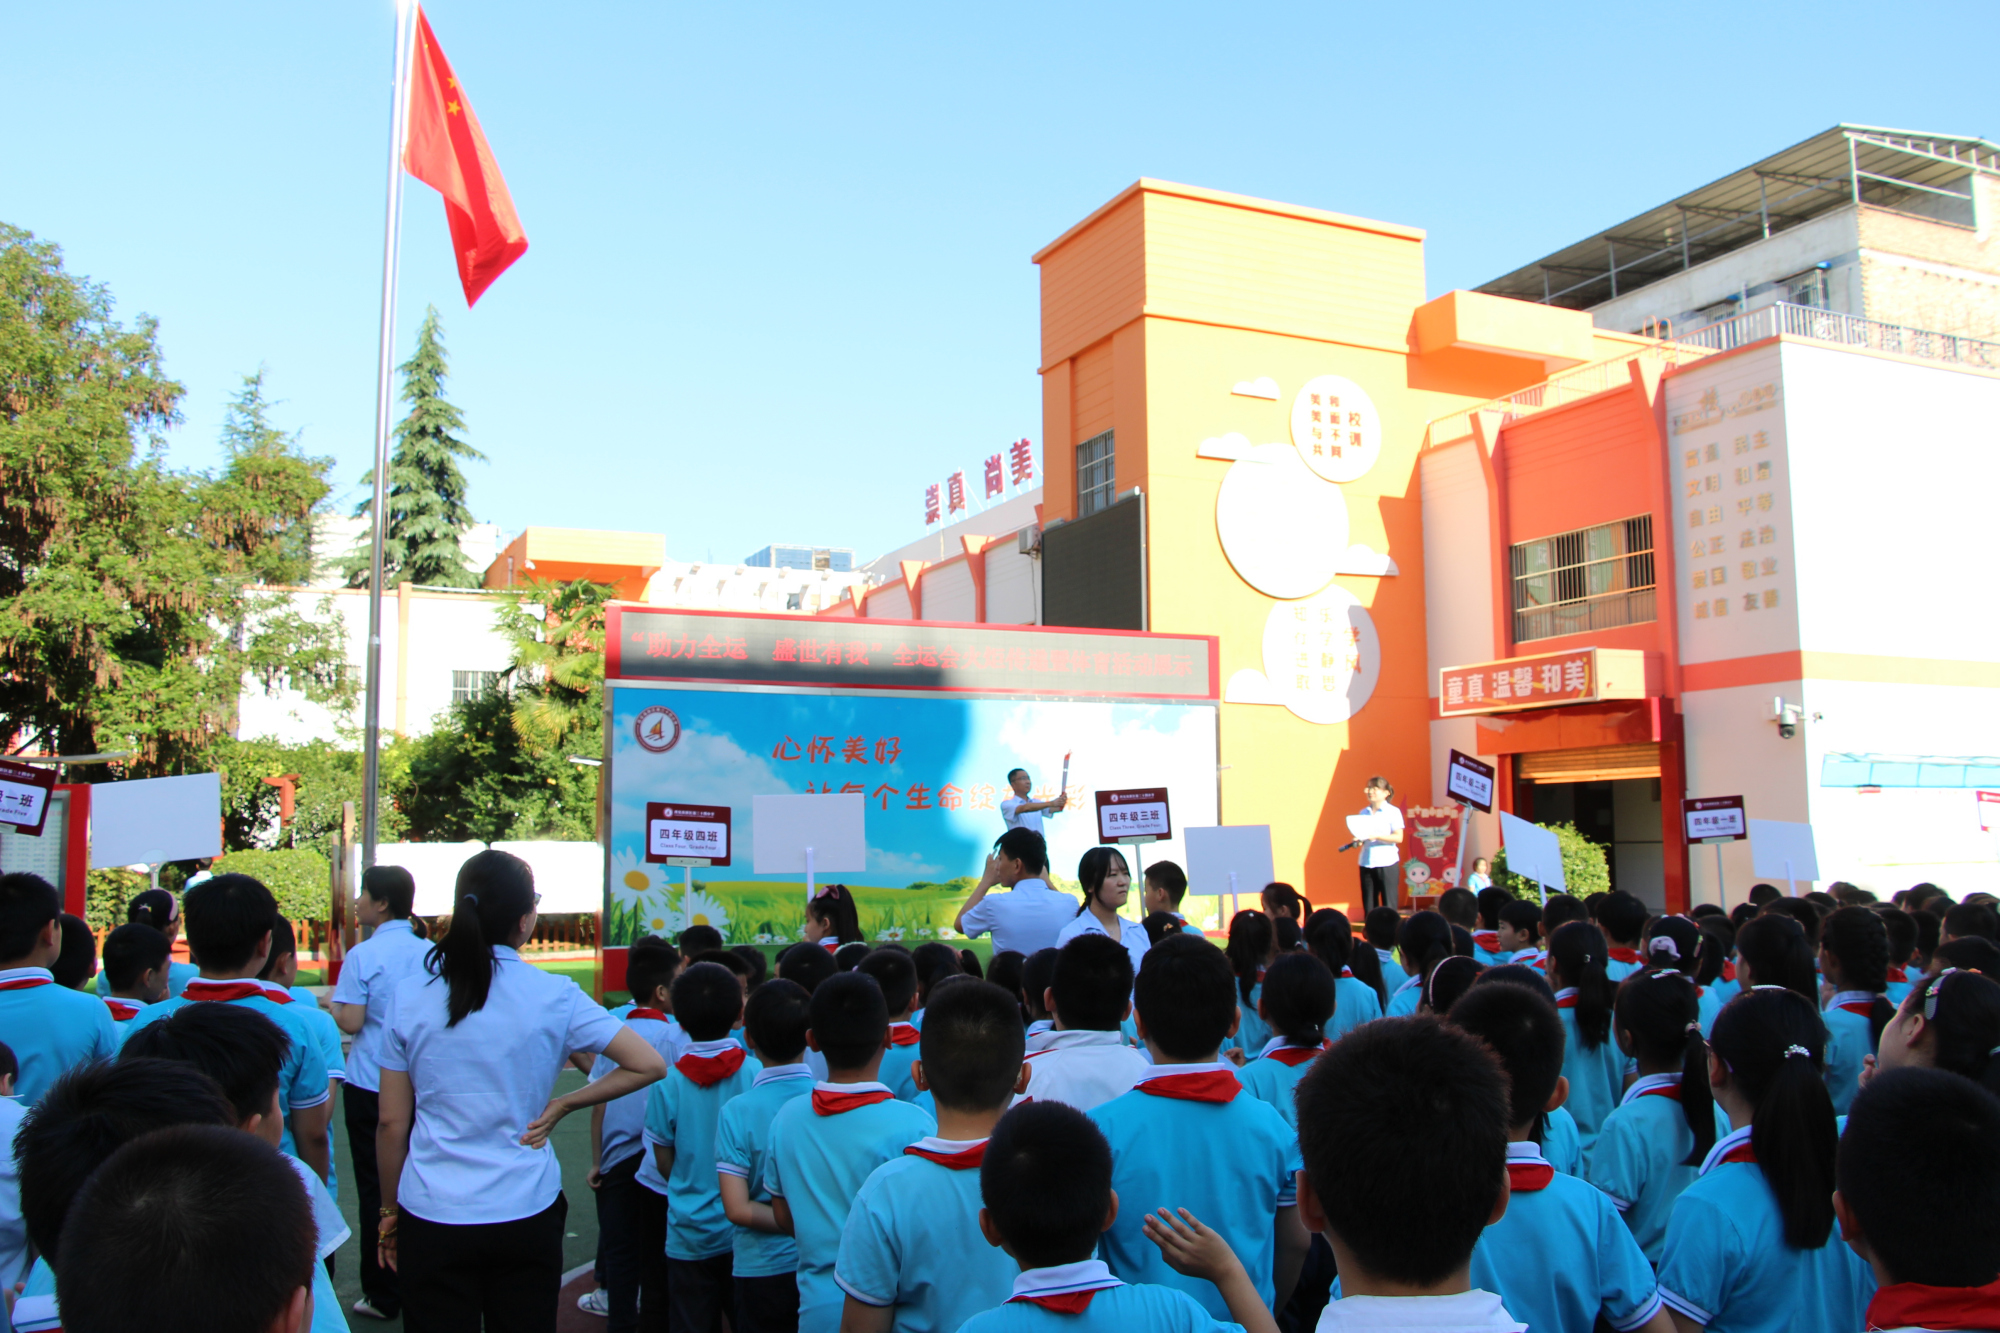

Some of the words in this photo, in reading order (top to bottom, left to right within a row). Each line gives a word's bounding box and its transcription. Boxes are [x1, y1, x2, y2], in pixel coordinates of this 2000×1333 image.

[1349, 411, 1361, 447] 校训
[1734, 430, 1769, 455] 民主
[984, 437, 1032, 500] 尚美
[1686, 474, 1721, 498] 文明
[1735, 461, 1771, 486] 和谐
[1690, 505, 1722, 528] 自由
[1737, 492, 1773, 517] 平等
[1690, 535, 1725, 558] 公正
[1739, 525, 1776, 549] 法治
[1692, 566, 1727, 589] 爱国
[1741, 557, 1777, 581] 敬业
[1694, 598, 1729, 619] 诚信
[1743, 588, 1779, 611] 友善
[1447, 673, 1485, 705] 童真
[1493, 667, 1533, 699] 温馨
[1541, 660, 1585, 693] 和美
[772, 735, 902, 765] 心怀美好
[1109, 810, 1160, 822] 四年级三班
[1694, 815, 1736, 826] 四年级一班
[660, 829, 718, 842] 四年级四班
